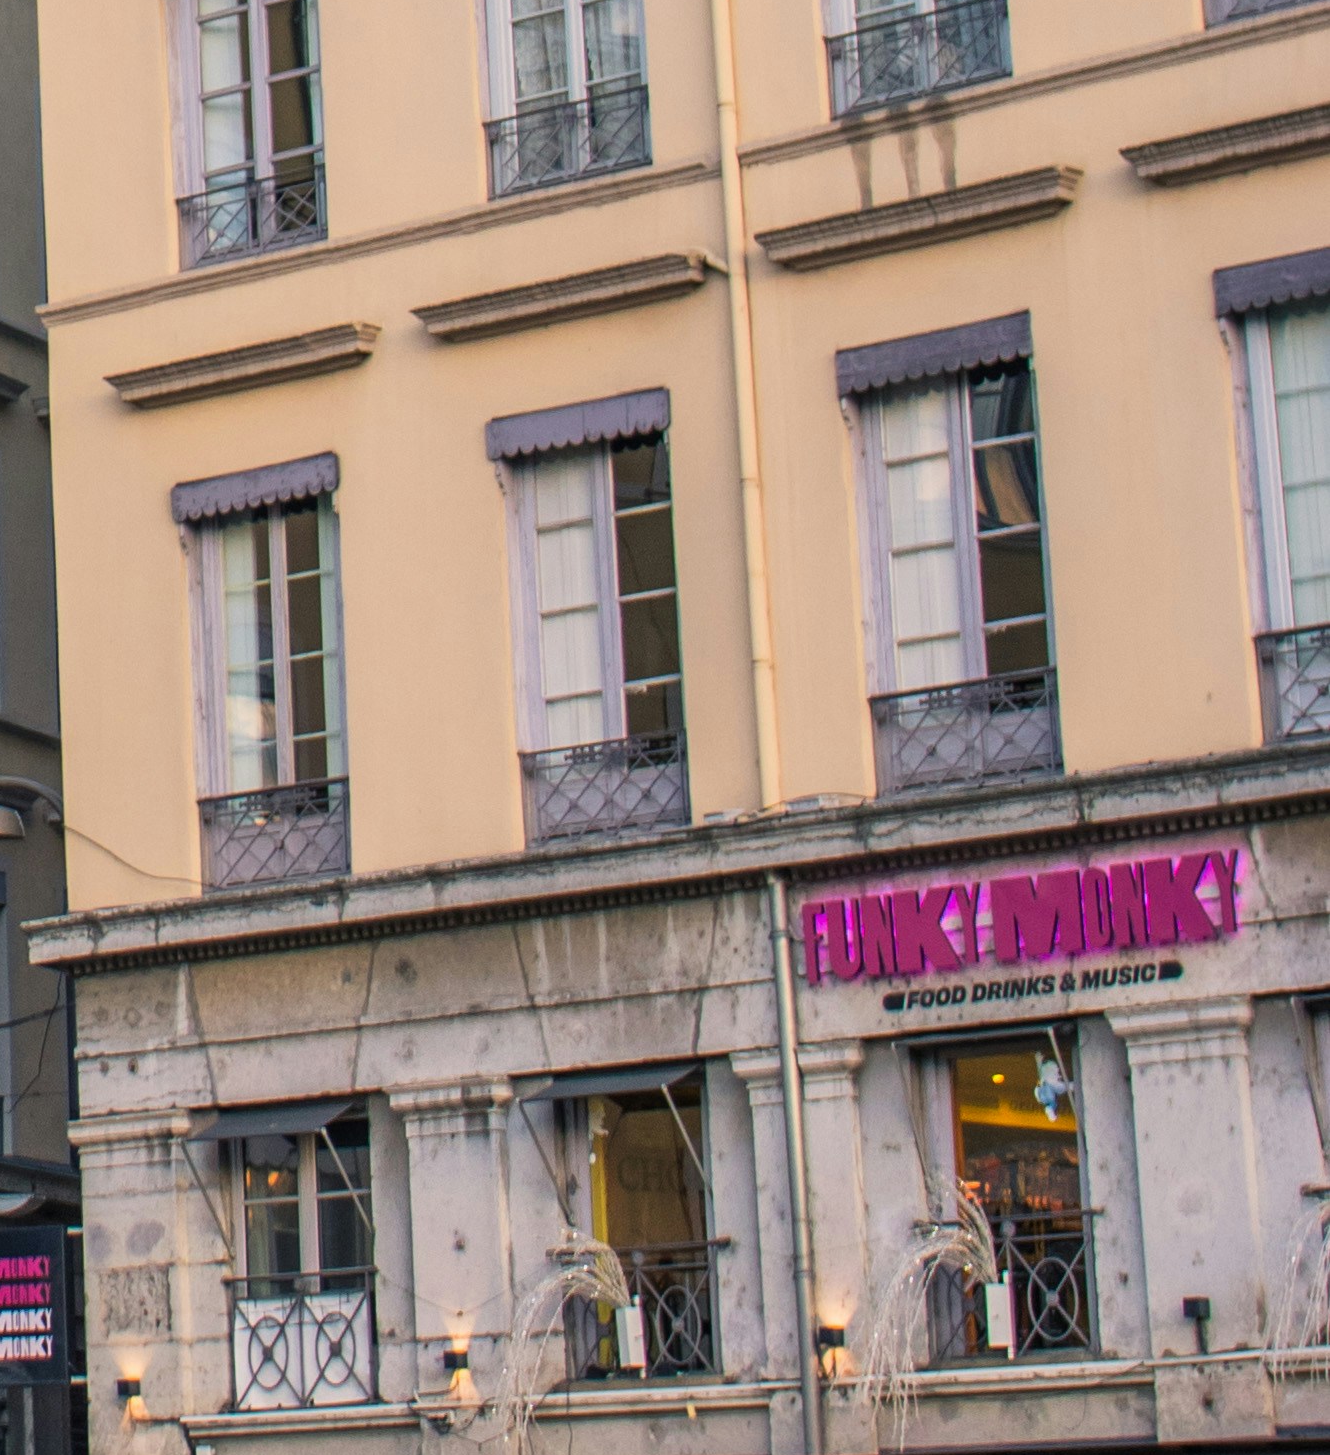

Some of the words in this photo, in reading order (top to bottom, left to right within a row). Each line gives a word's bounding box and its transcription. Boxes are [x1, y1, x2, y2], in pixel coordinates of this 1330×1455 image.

[802, 881, 981, 986] FUNKY
[990, 849, 1239, 966] MONKY
[905, 983, 965, 1010] FOOD
[972, 974, 1055, 1004] DRINKS
[1059, 972, 1078, 992] &
[1081, 961, 1157, 990] MUSIC
